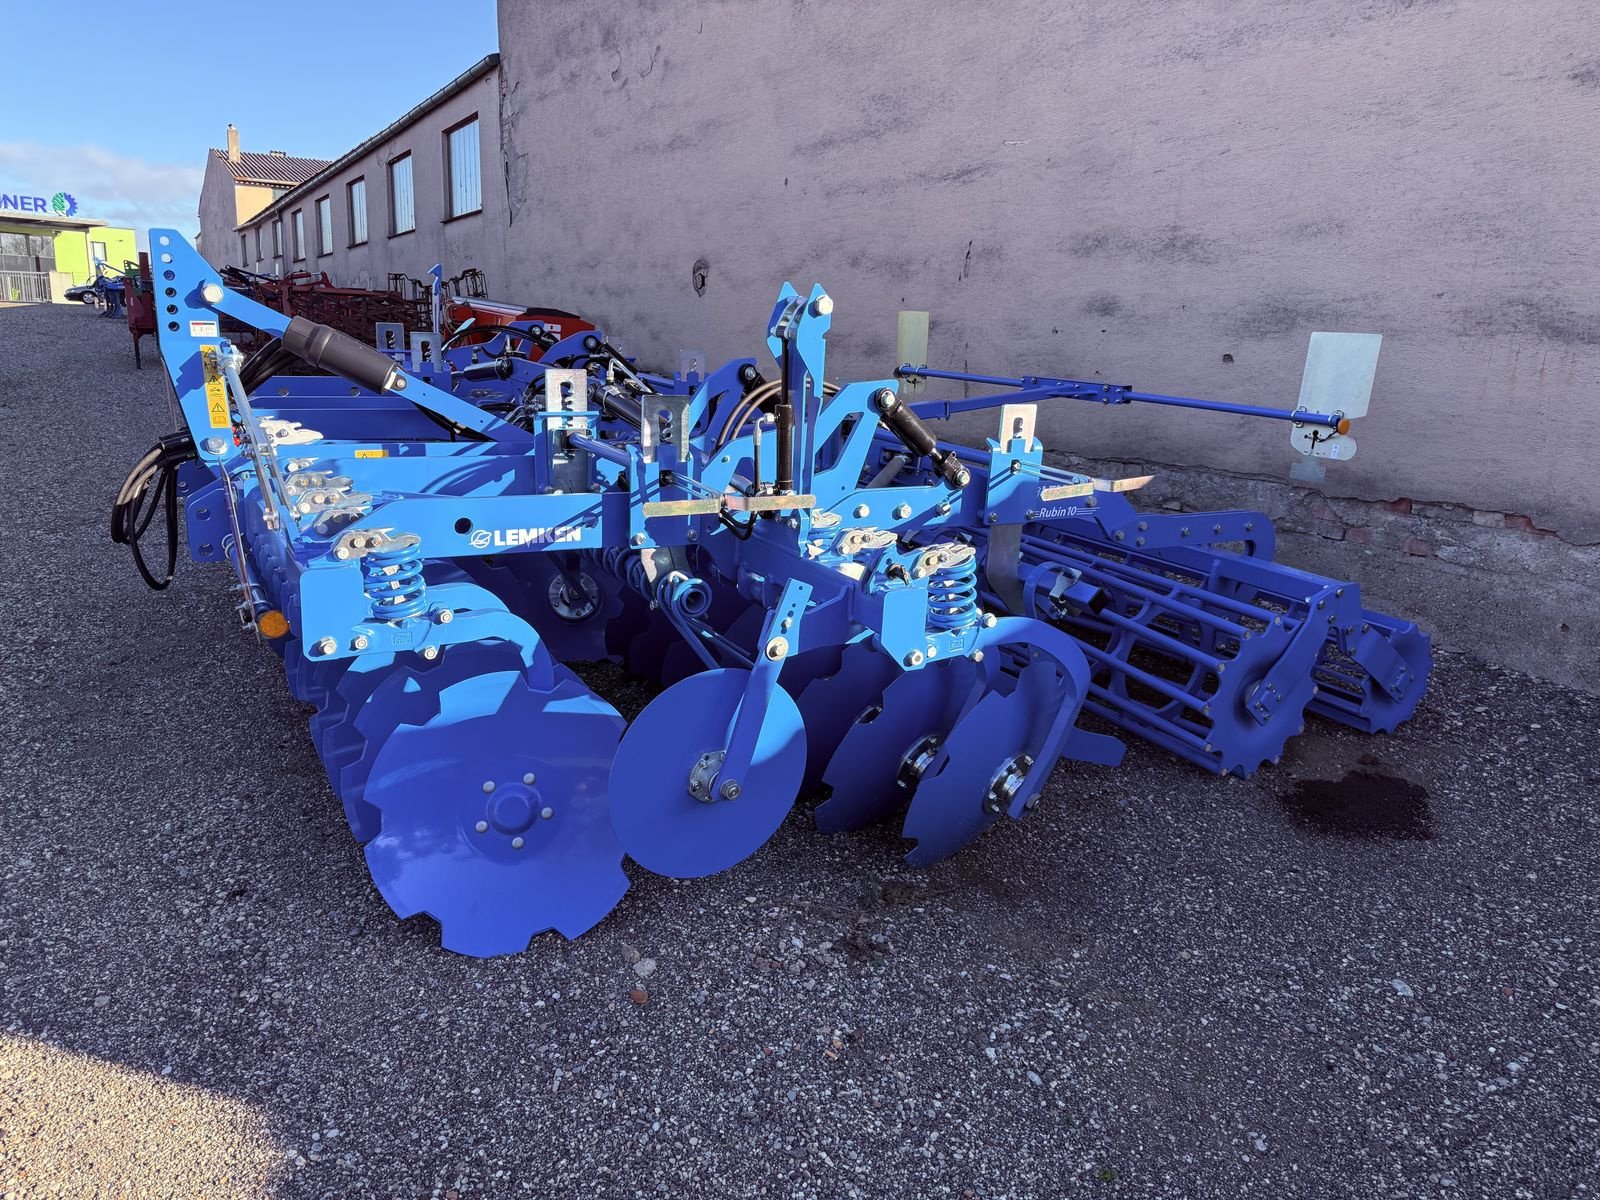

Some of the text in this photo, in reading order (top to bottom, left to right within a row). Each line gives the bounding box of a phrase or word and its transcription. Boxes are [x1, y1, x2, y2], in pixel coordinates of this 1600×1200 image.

[1039, 506, 1077, 518] Rubin 10
[494, 526, 582, 547] LEMKEN
